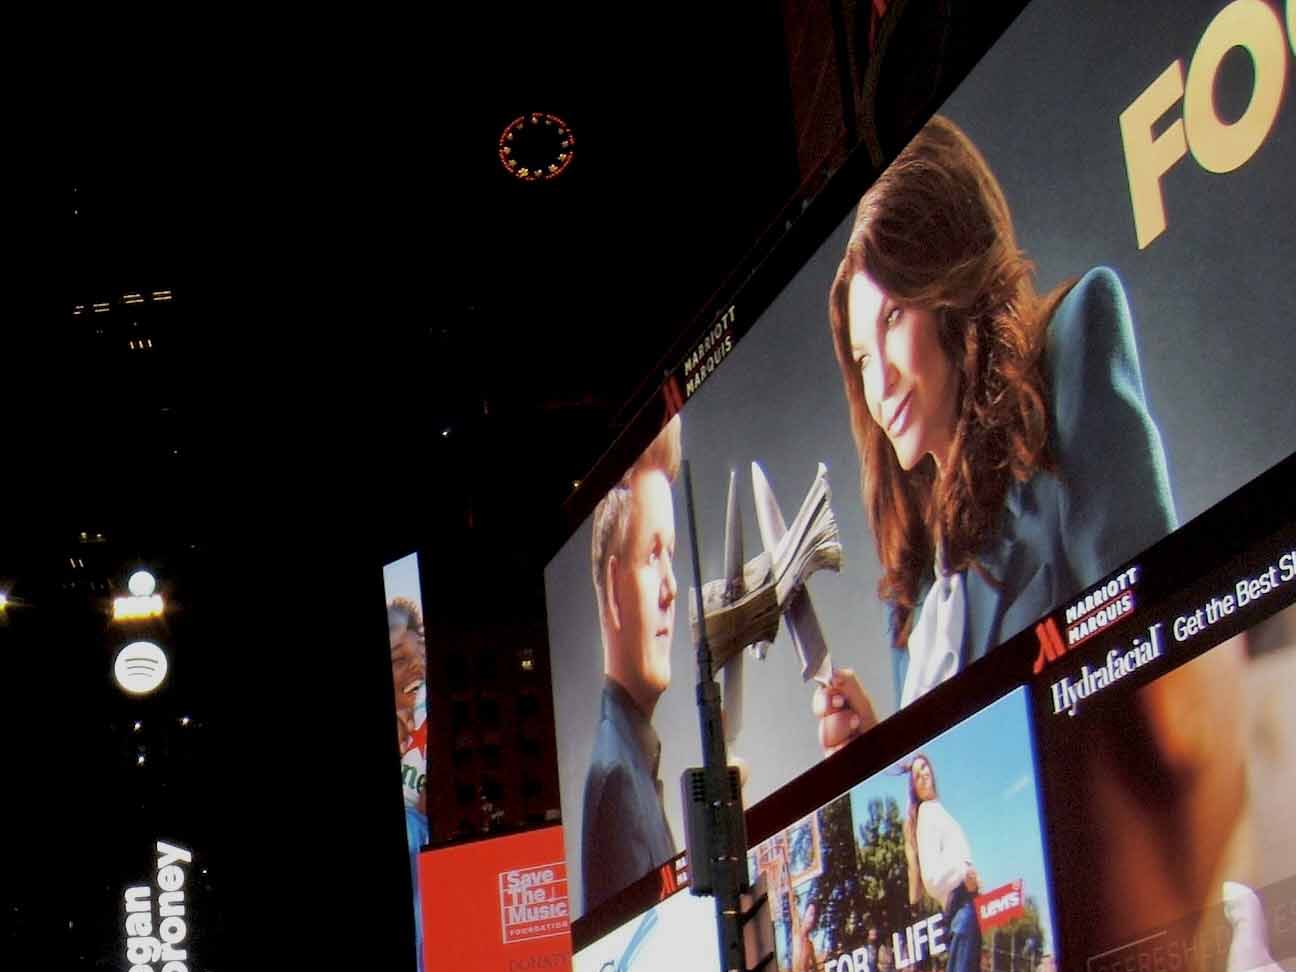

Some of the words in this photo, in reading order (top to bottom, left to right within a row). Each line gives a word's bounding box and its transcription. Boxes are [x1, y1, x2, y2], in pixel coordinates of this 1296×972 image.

[1119, 0, 1296, 250] FO
[685, 305, 735, 376] MARRIOTT
[686, 335, 732, 397] MARQUIS
[1065, 567, 1139, 624] MARRIOTT
[1068, 594, 1133, 644] MARQUIS
[1173, 608, 1205, 642] Get
[1206, 593, 1236, 625] the
[1235, 566, 1280, 608] Best
[507, 869, 554, 889] Save
[508, 888, 546, 908] The
[509, 901, 567, 925] Music
[891, 912, 947, 970] LIFE
